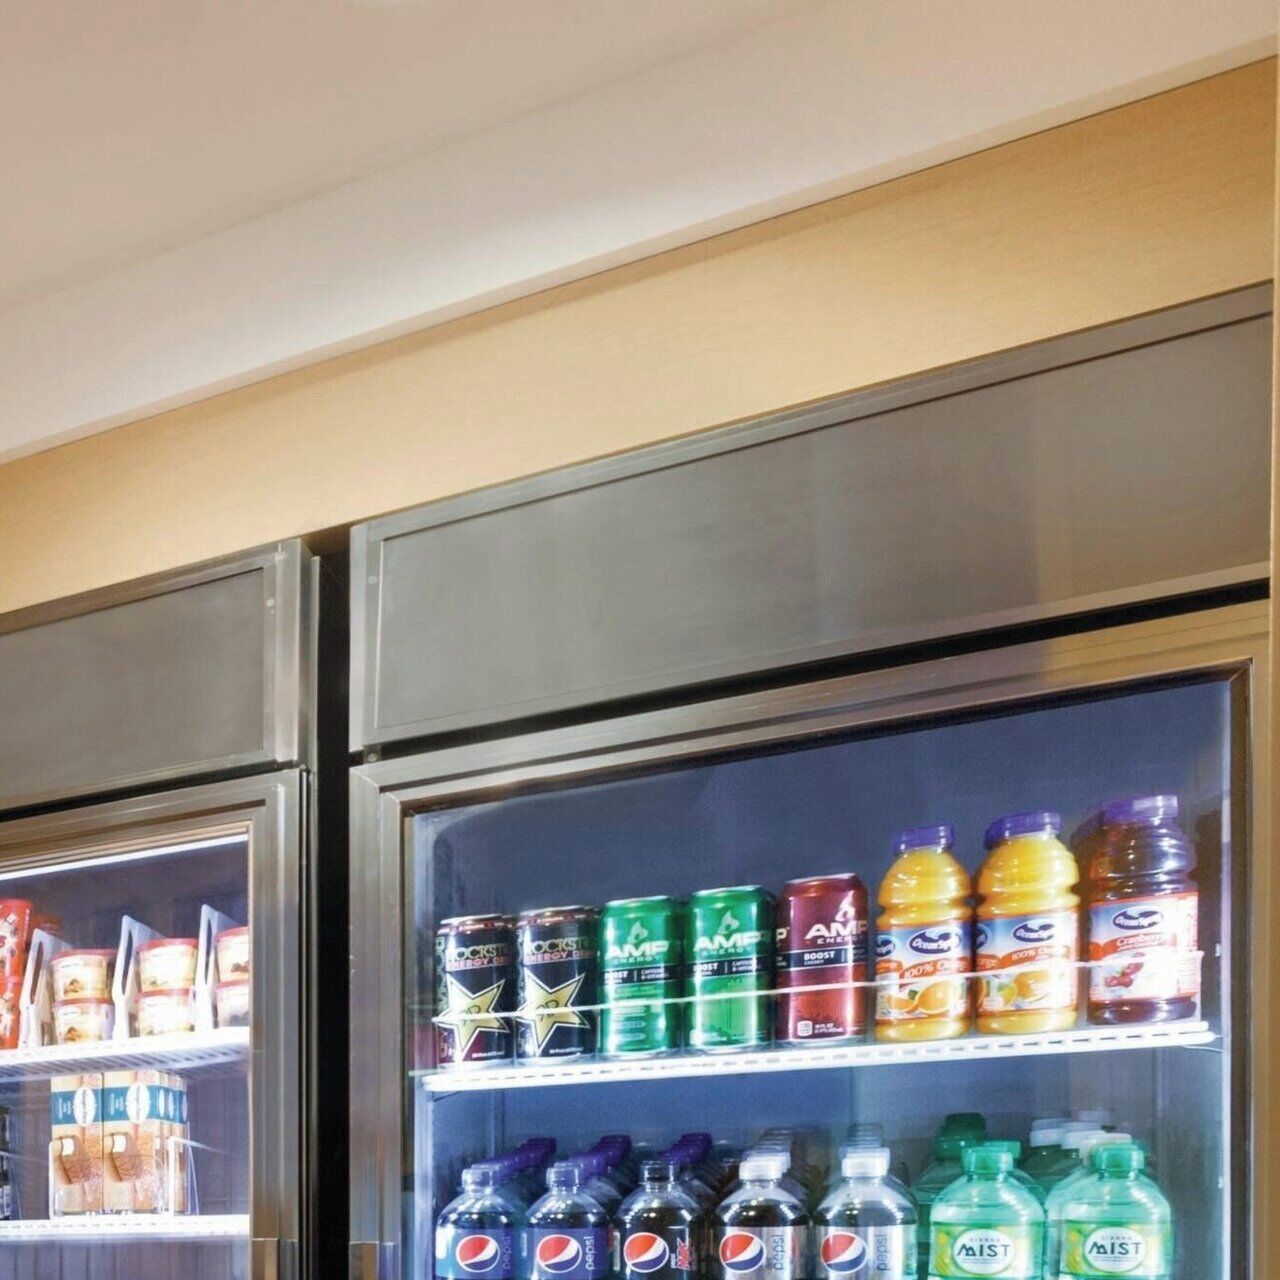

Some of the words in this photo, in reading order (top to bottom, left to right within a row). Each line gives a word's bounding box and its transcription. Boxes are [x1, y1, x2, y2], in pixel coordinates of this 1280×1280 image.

[805, 921, 868, 940] AMP
[606, 940, 669, 960] AMP
[694, 931, 761, 951] AMP
[804, 951, 835, 961] BOOST
[1012, 949, 1036, 961] 100%
[903, 963, 934, 979] 100%
[502, 1236, 513, 1269] pepsi
[585, 1235, 596, 1271] pepsi
[772, 1234, 784, 1271] pepsi
[875, 1234, 887, 1271] pepsi
[957, 1243, 1010, 1258] MIST
[1088, 1241, 1143, 1257] MIST
